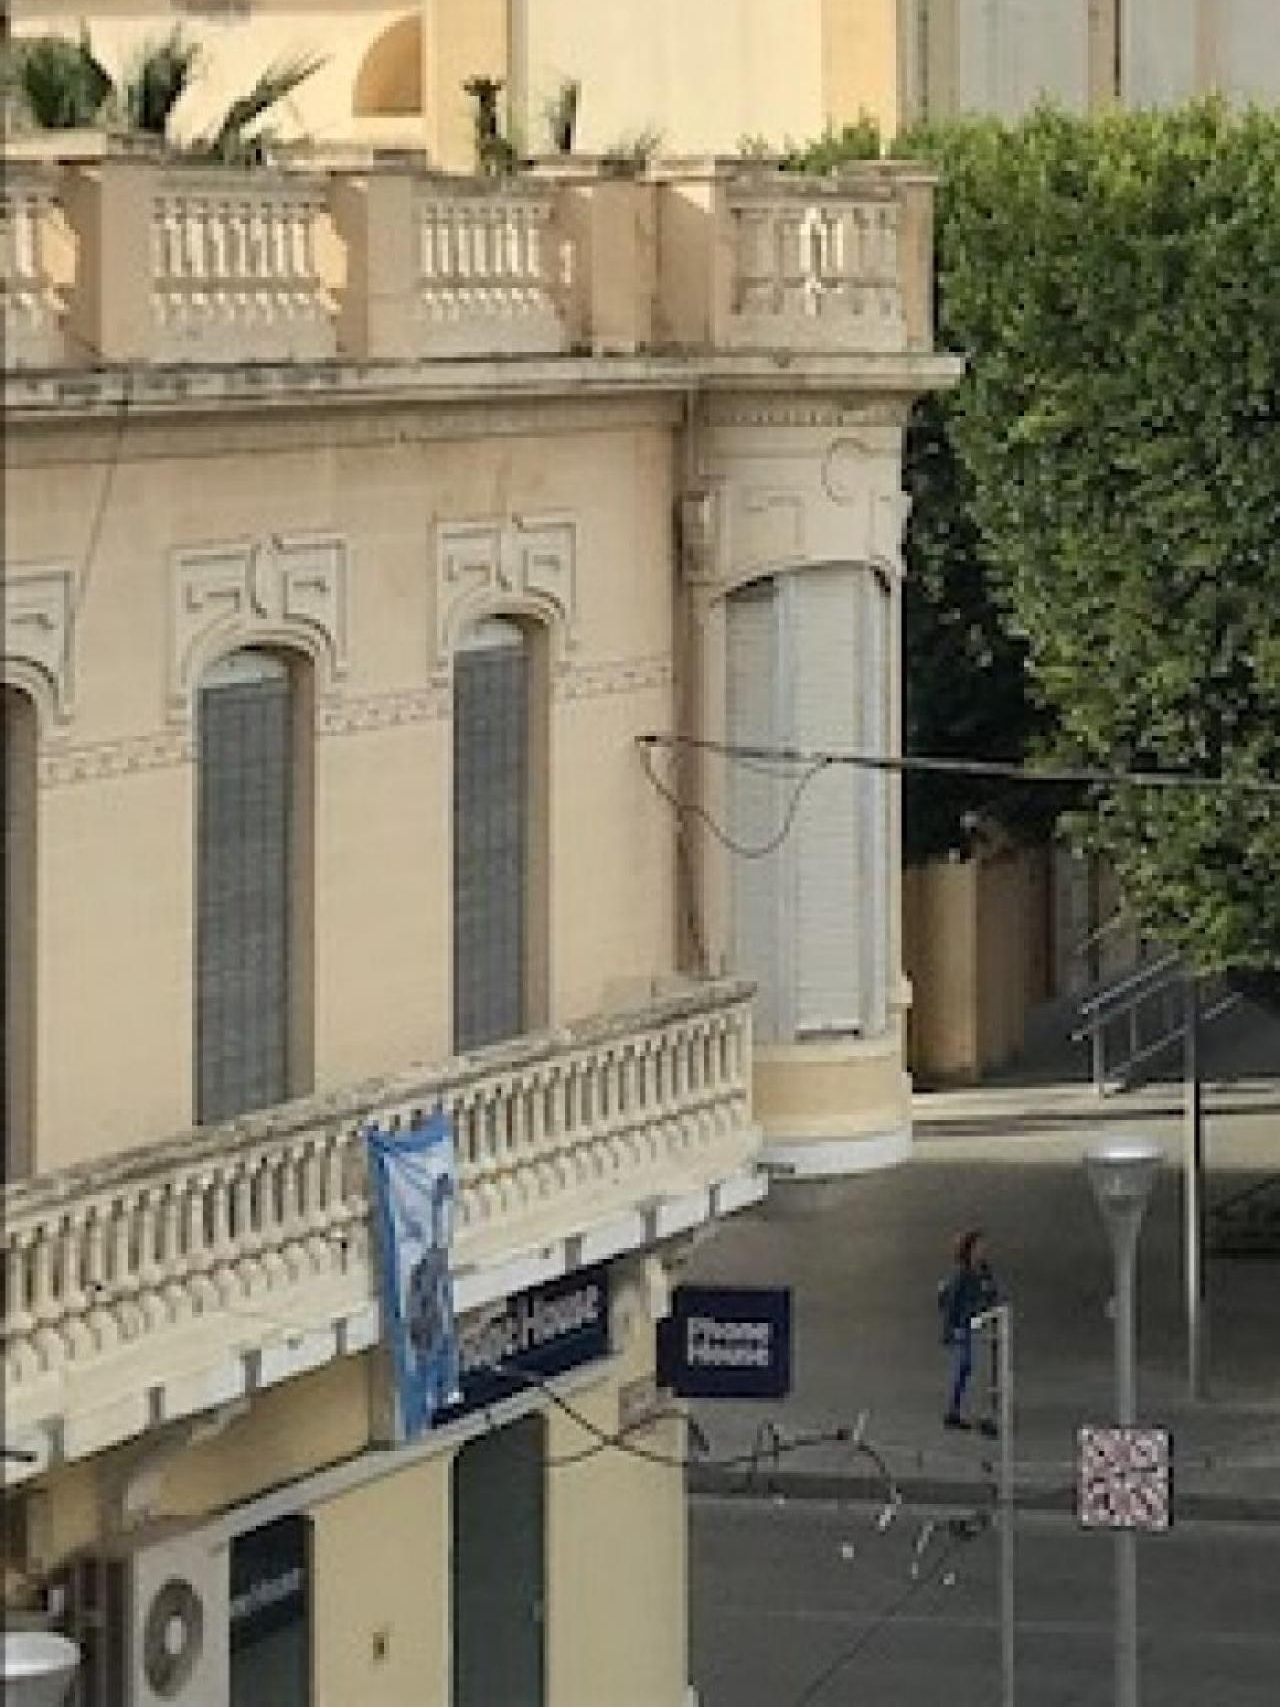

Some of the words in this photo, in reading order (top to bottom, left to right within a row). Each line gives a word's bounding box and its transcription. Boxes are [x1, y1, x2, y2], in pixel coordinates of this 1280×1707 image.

[516, 1283, 600, 1351] House
[686, 1316, 771, 1342] Phone
[686, 1342, 771, 1367] House
